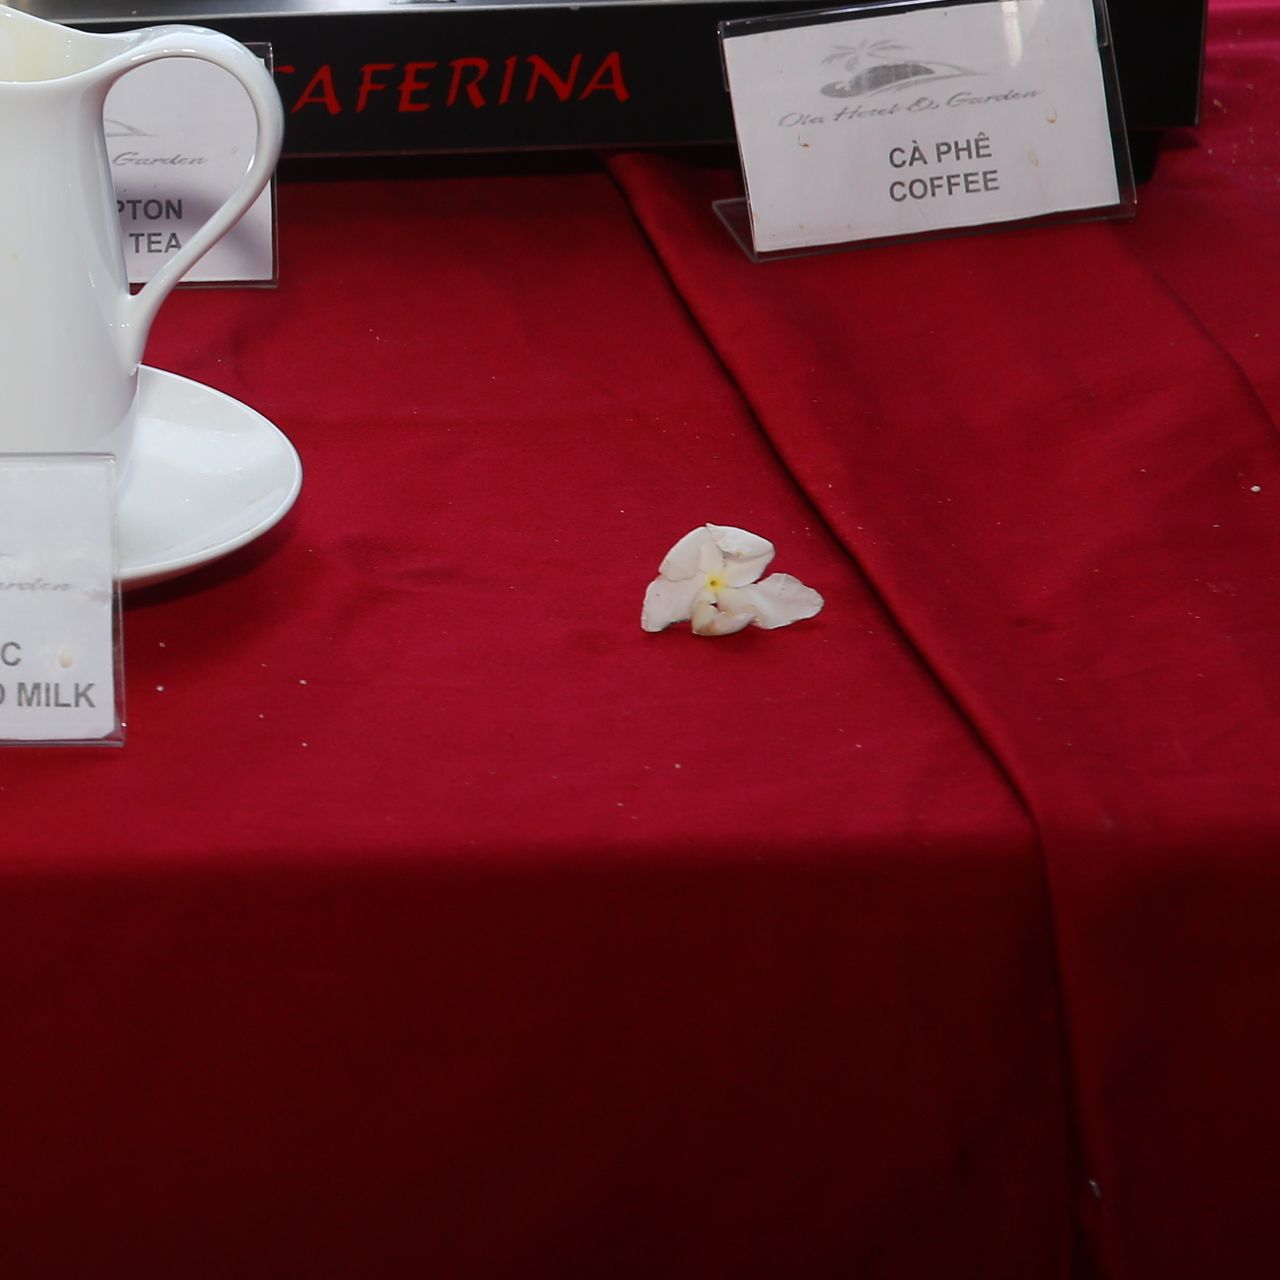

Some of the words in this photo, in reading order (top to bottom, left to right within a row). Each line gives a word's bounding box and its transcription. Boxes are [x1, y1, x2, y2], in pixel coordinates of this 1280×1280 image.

[273, 51, 631, 117] AFERINA
[831, 103, 902, 122] Hotel
[945, 88, 1042, 109] Garden
[111, 151, 209, 166] Garden
[888, 140, 928, 169] CÀ
[935, 132, 993, 163] PHÊ
[889, 169, 1000, 203] COFFEE
[116, 199, 183, 220] PTON
[129, 232, 183, 254] TEA
[16, 681, 96, 708] MILK
